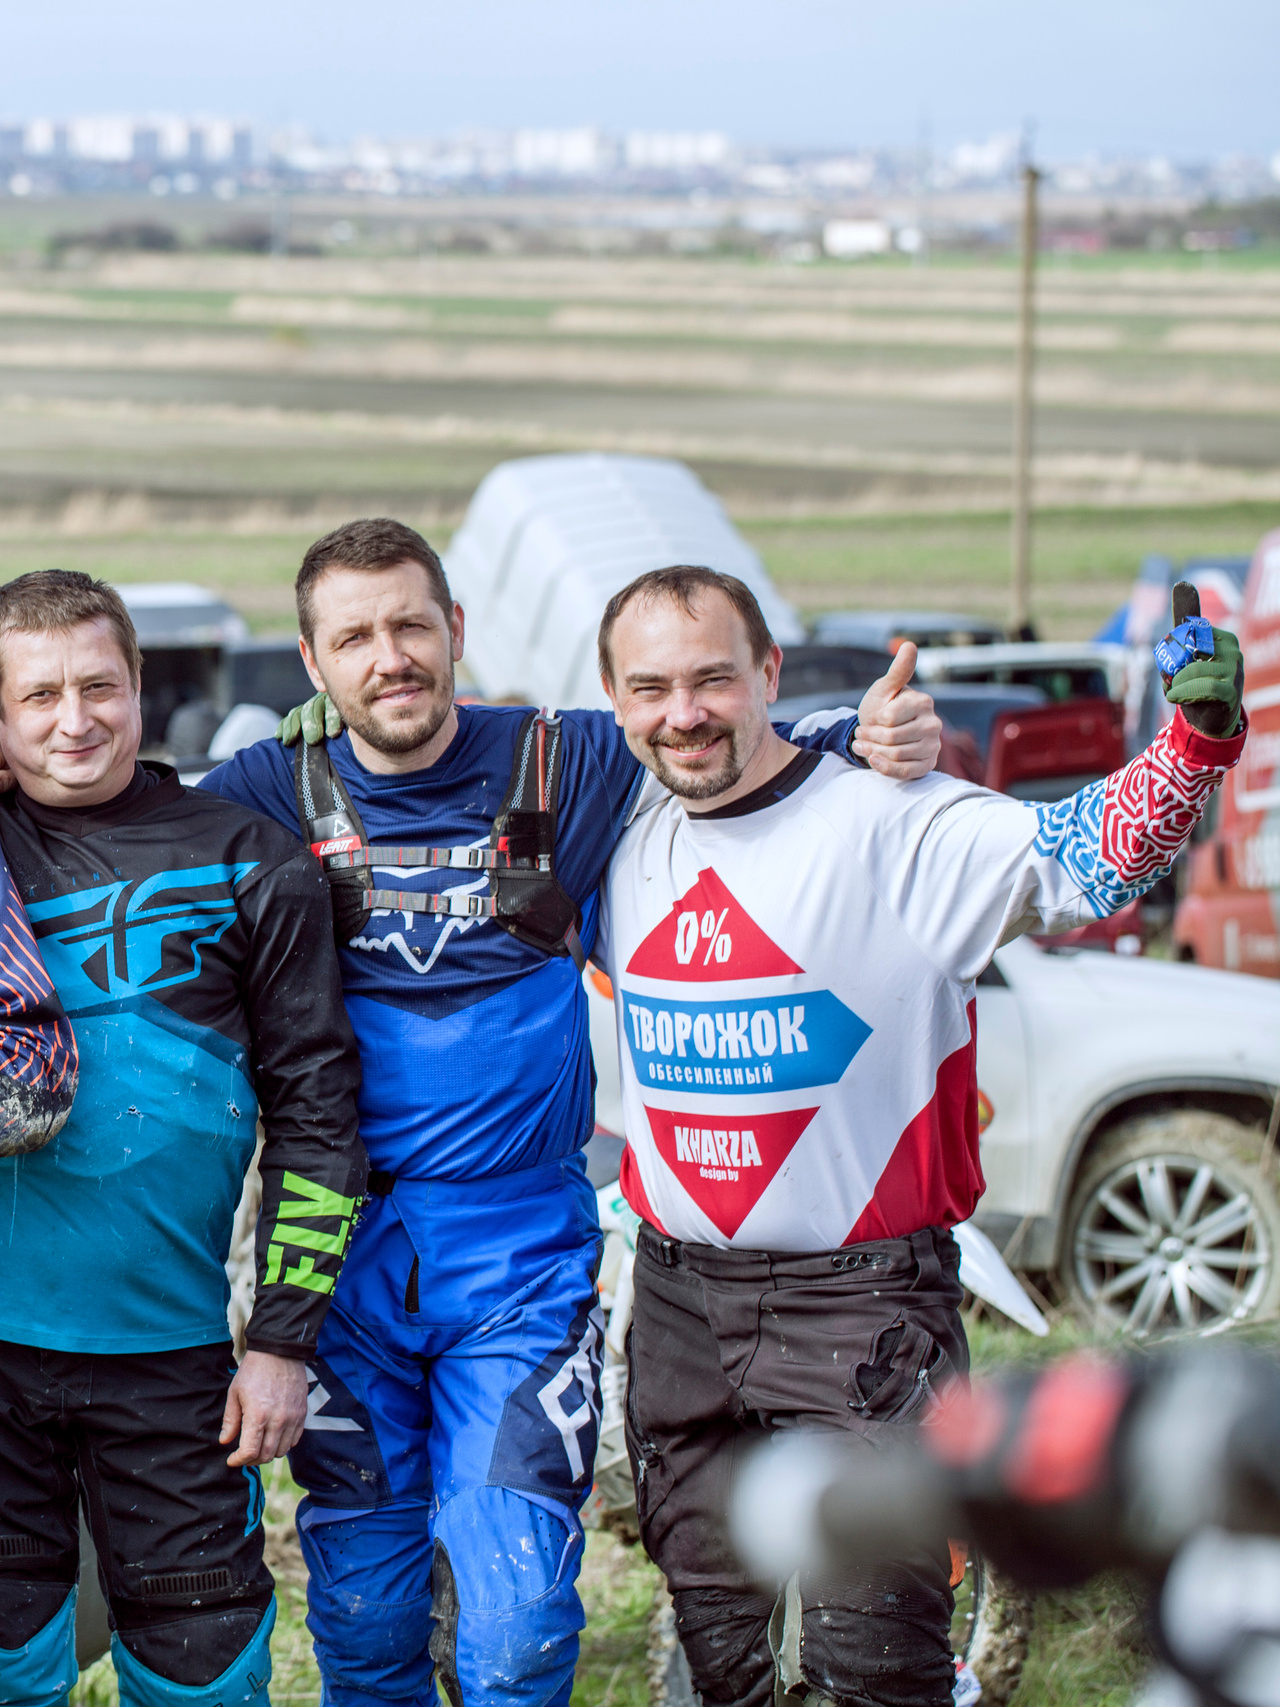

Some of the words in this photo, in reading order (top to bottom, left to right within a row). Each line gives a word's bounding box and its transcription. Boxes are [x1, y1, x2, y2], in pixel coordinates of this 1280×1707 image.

[319, 839, 354, 856] LEATT
[29, 867, 122, 897] ACING
[674, 908, 732, 966] 0%
[628, 1003, 809, 1060] ТВОРОЖОК
[648, 1062, 774, 1085] ОБЕССИЛЕННЫЙ
[674, 1126, 763, 1168] KHARZA
[699, 1166, 727, 1181] design
[727, 1168, 739, 1182] by
[262, 1170, 356, 1295] FLY
